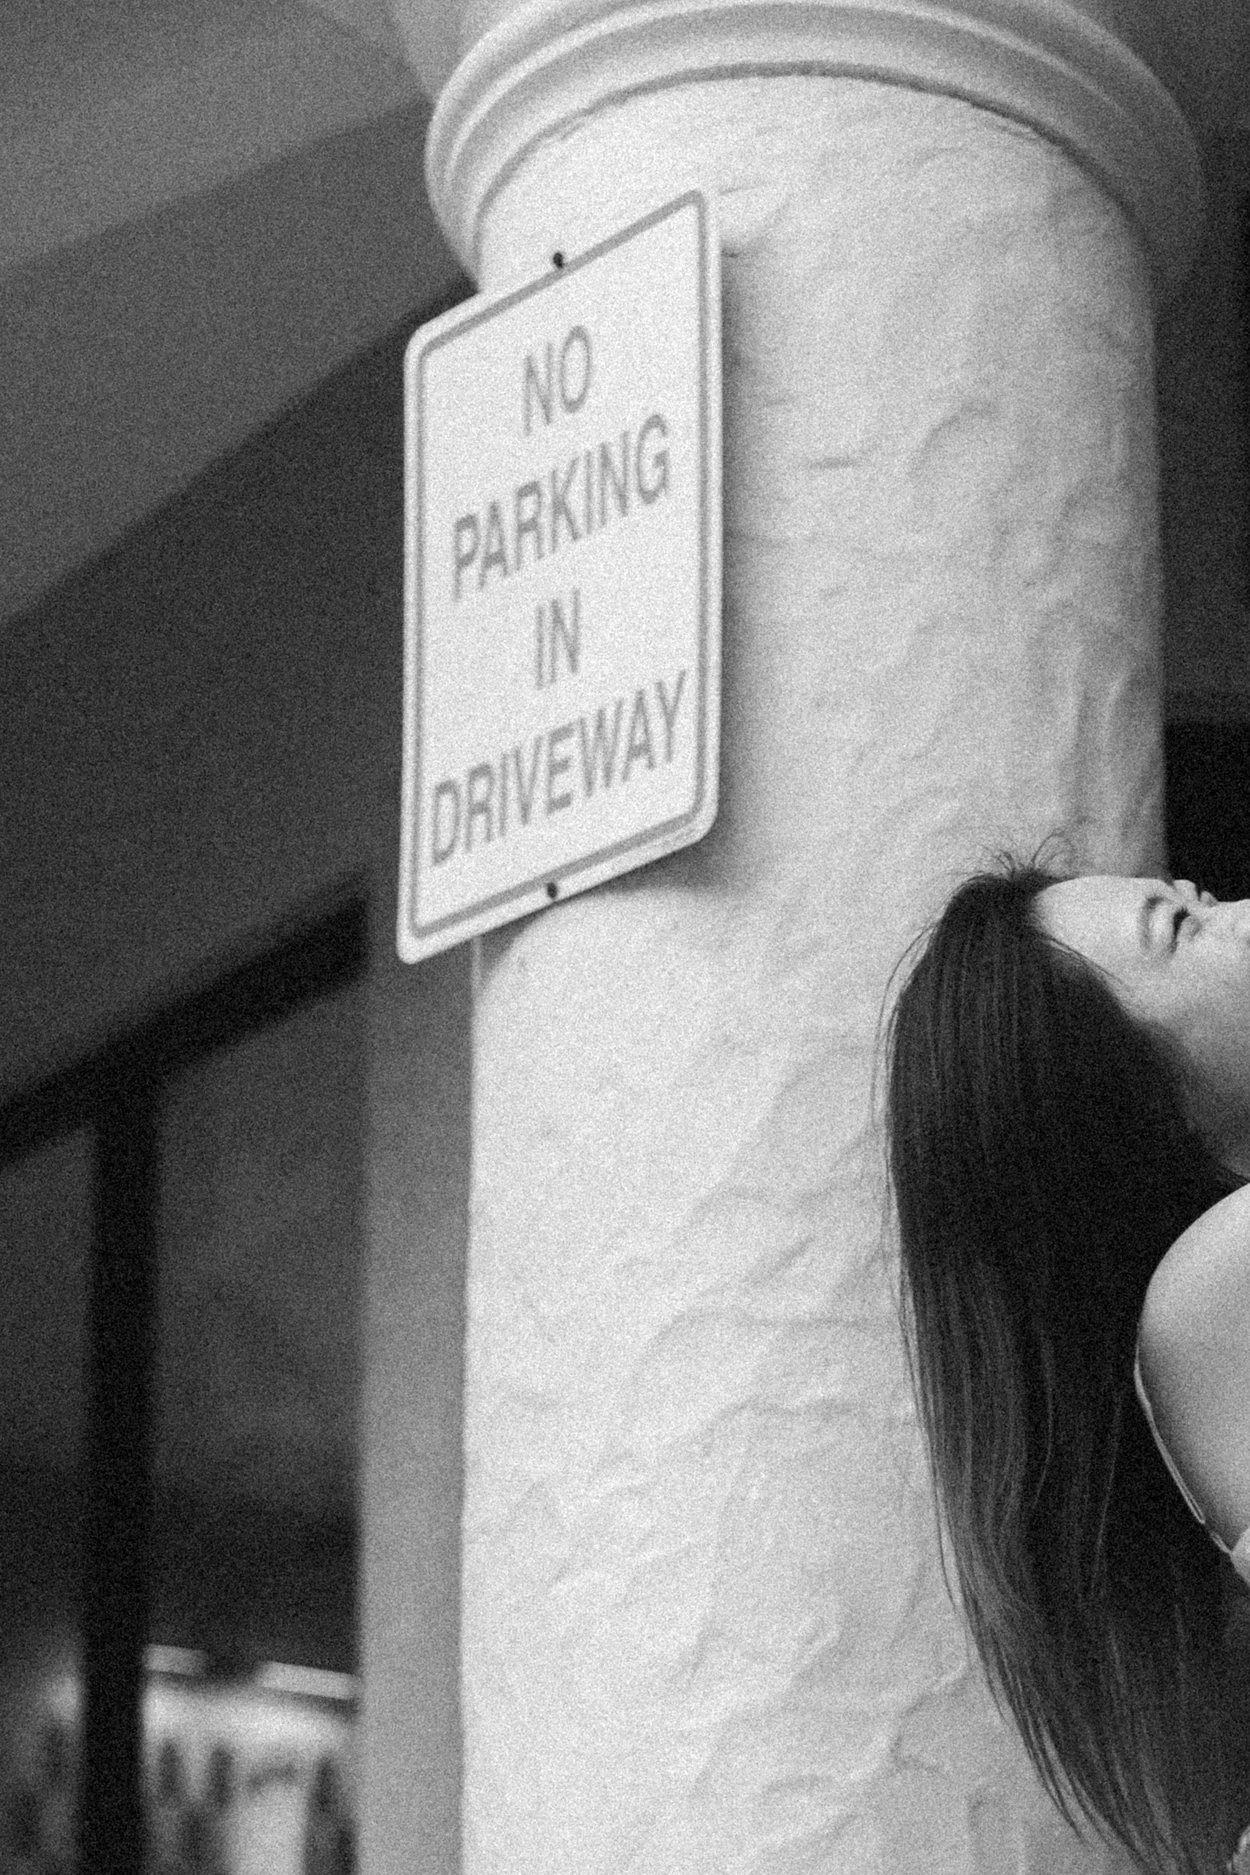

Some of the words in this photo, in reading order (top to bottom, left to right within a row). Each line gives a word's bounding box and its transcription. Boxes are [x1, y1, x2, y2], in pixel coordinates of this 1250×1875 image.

[522, 325, 592, 436] NO
[452, 413, 669, 600] PARKING
[535, 587, 581, 691] IN
[431, 670, 687, 867] DRIVEWAY
